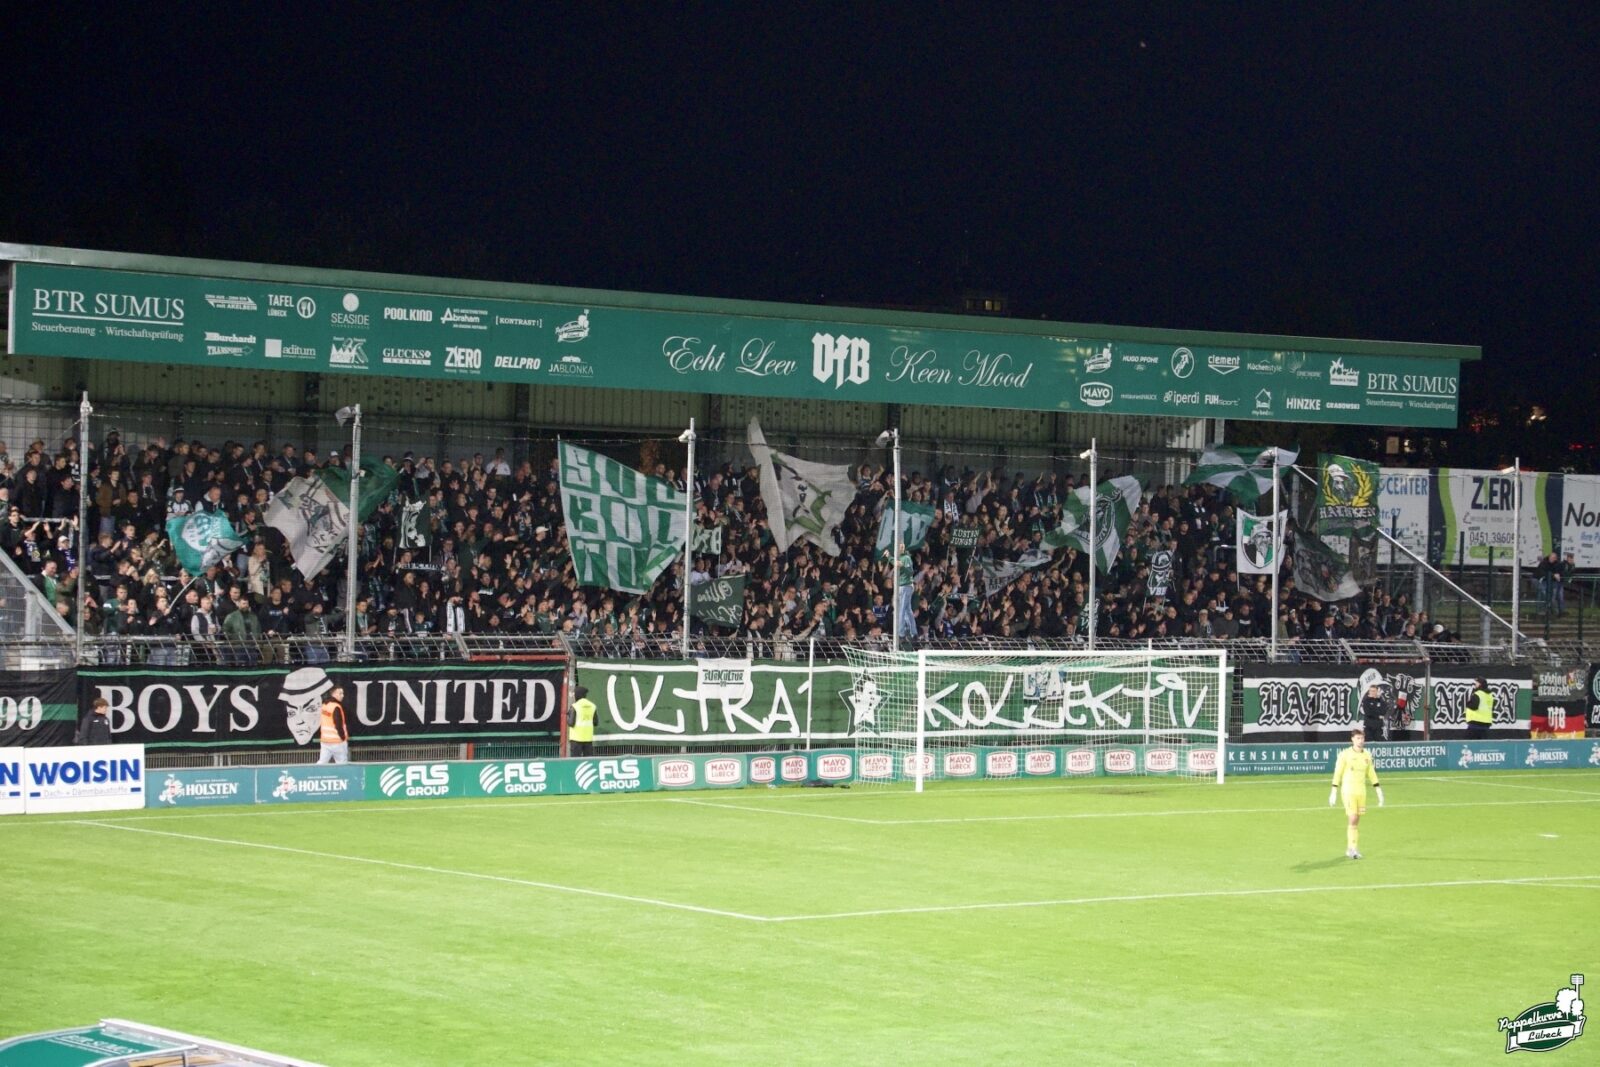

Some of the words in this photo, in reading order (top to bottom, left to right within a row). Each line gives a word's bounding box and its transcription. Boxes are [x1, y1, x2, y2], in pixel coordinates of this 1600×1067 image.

[33, 288, 85, 314] BTR
[94, 293, 185, 320] SUMUS
[268, 294, 294, 308] TAFEL
[330, 312, 370, 326] SEASIDE
[32, 321, 96, 337] Steuerberatung
[105, 326, 184, 342] Wirtschaftsprüfung
[283, 344, 316, 356] aditum
[494, 355, 541, 370] DELLPRO
[662, 335, 726, 375] Echt
[885, 345, 953, 385] Keen
[958, 349, 1034, 389] Mood
[1207, 354, 1240, 366] clement
[548, 363, 594, 375] JABLONKA
[1367, 372, 1398, 391] BTR
[1402, 374, 1457, 394] SUMUS
[1083, 387, 1110, 399] MAYO
[1173, 390, 1200, 406] iperdi
[1286, 397, 1321, 411] HINZKE
[95, 684, 259, 734] BOYS
[353, 677, 556, 727] UNITED
[1229, 750, 1329, 761] KENSINGTON
[1473, 752, 1506, 763] HOLSTEN
[1539, 751, 1568, 761] HOLSTEN
[599, 759, 641, 779] FLS
[664, 764, 689, 773] MAYO
[711, 762, 736, 771] MAYO
[754, 760, 772, 769] MAYO
[785, 759, 803, 768] MAYO
[823, 758, 846, 767] MAYO
[1408, 757, 1437, 768] BUCHT.
[29, 759, 141, 786] WOISIN
[406, 764, 450, 784] FLS
[504, 762, 547, 781] FLS
[186, 782, 239, 796] HOLSTEN
[299, 779, 348, 793] HOLSTEN
[406, 784, 449, 796] GROUP
[504, 782, 547, 793] GROUP
[600, 778, 641, 790] GROUP
